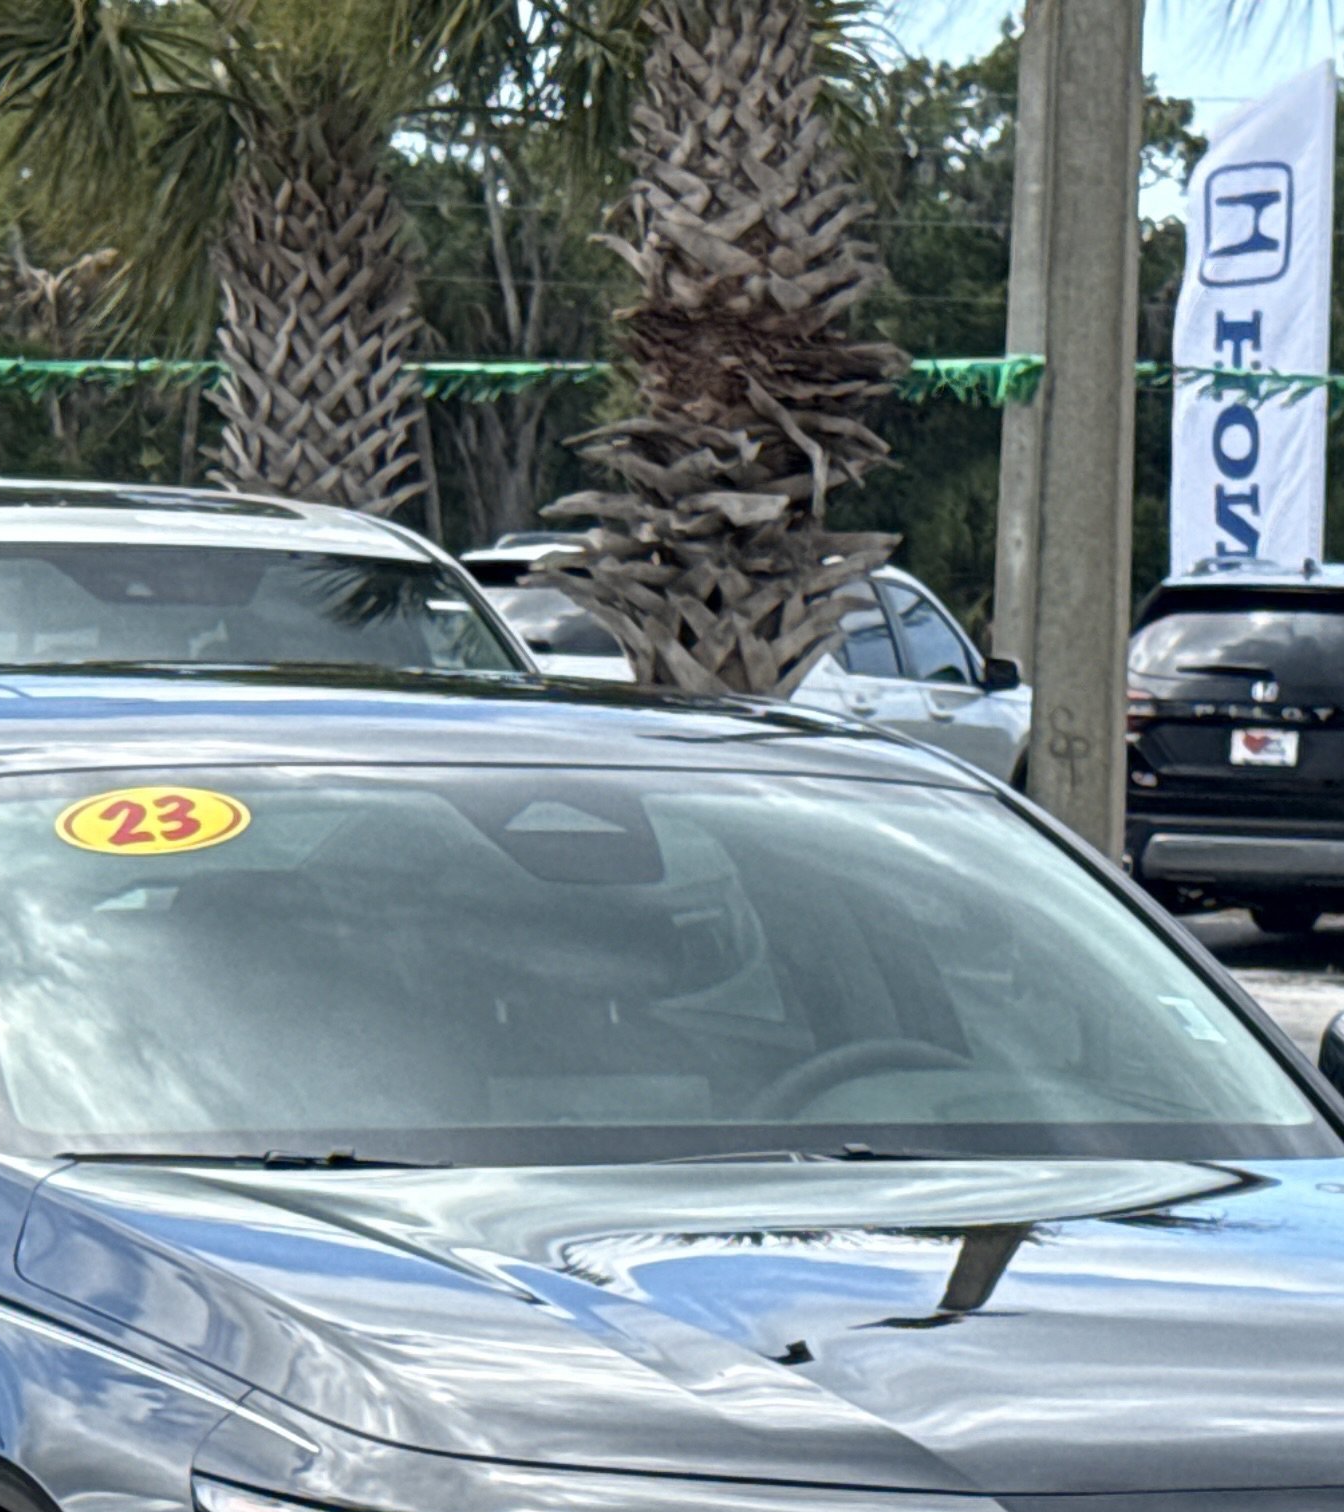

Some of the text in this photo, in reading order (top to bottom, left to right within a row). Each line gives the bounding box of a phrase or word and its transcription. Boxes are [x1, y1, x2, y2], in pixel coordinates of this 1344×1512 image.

[1212, 309, 1262, 567] HON
[1194, 703, 1334, 722] PILOT
[98, 794, 202, 846] 23
